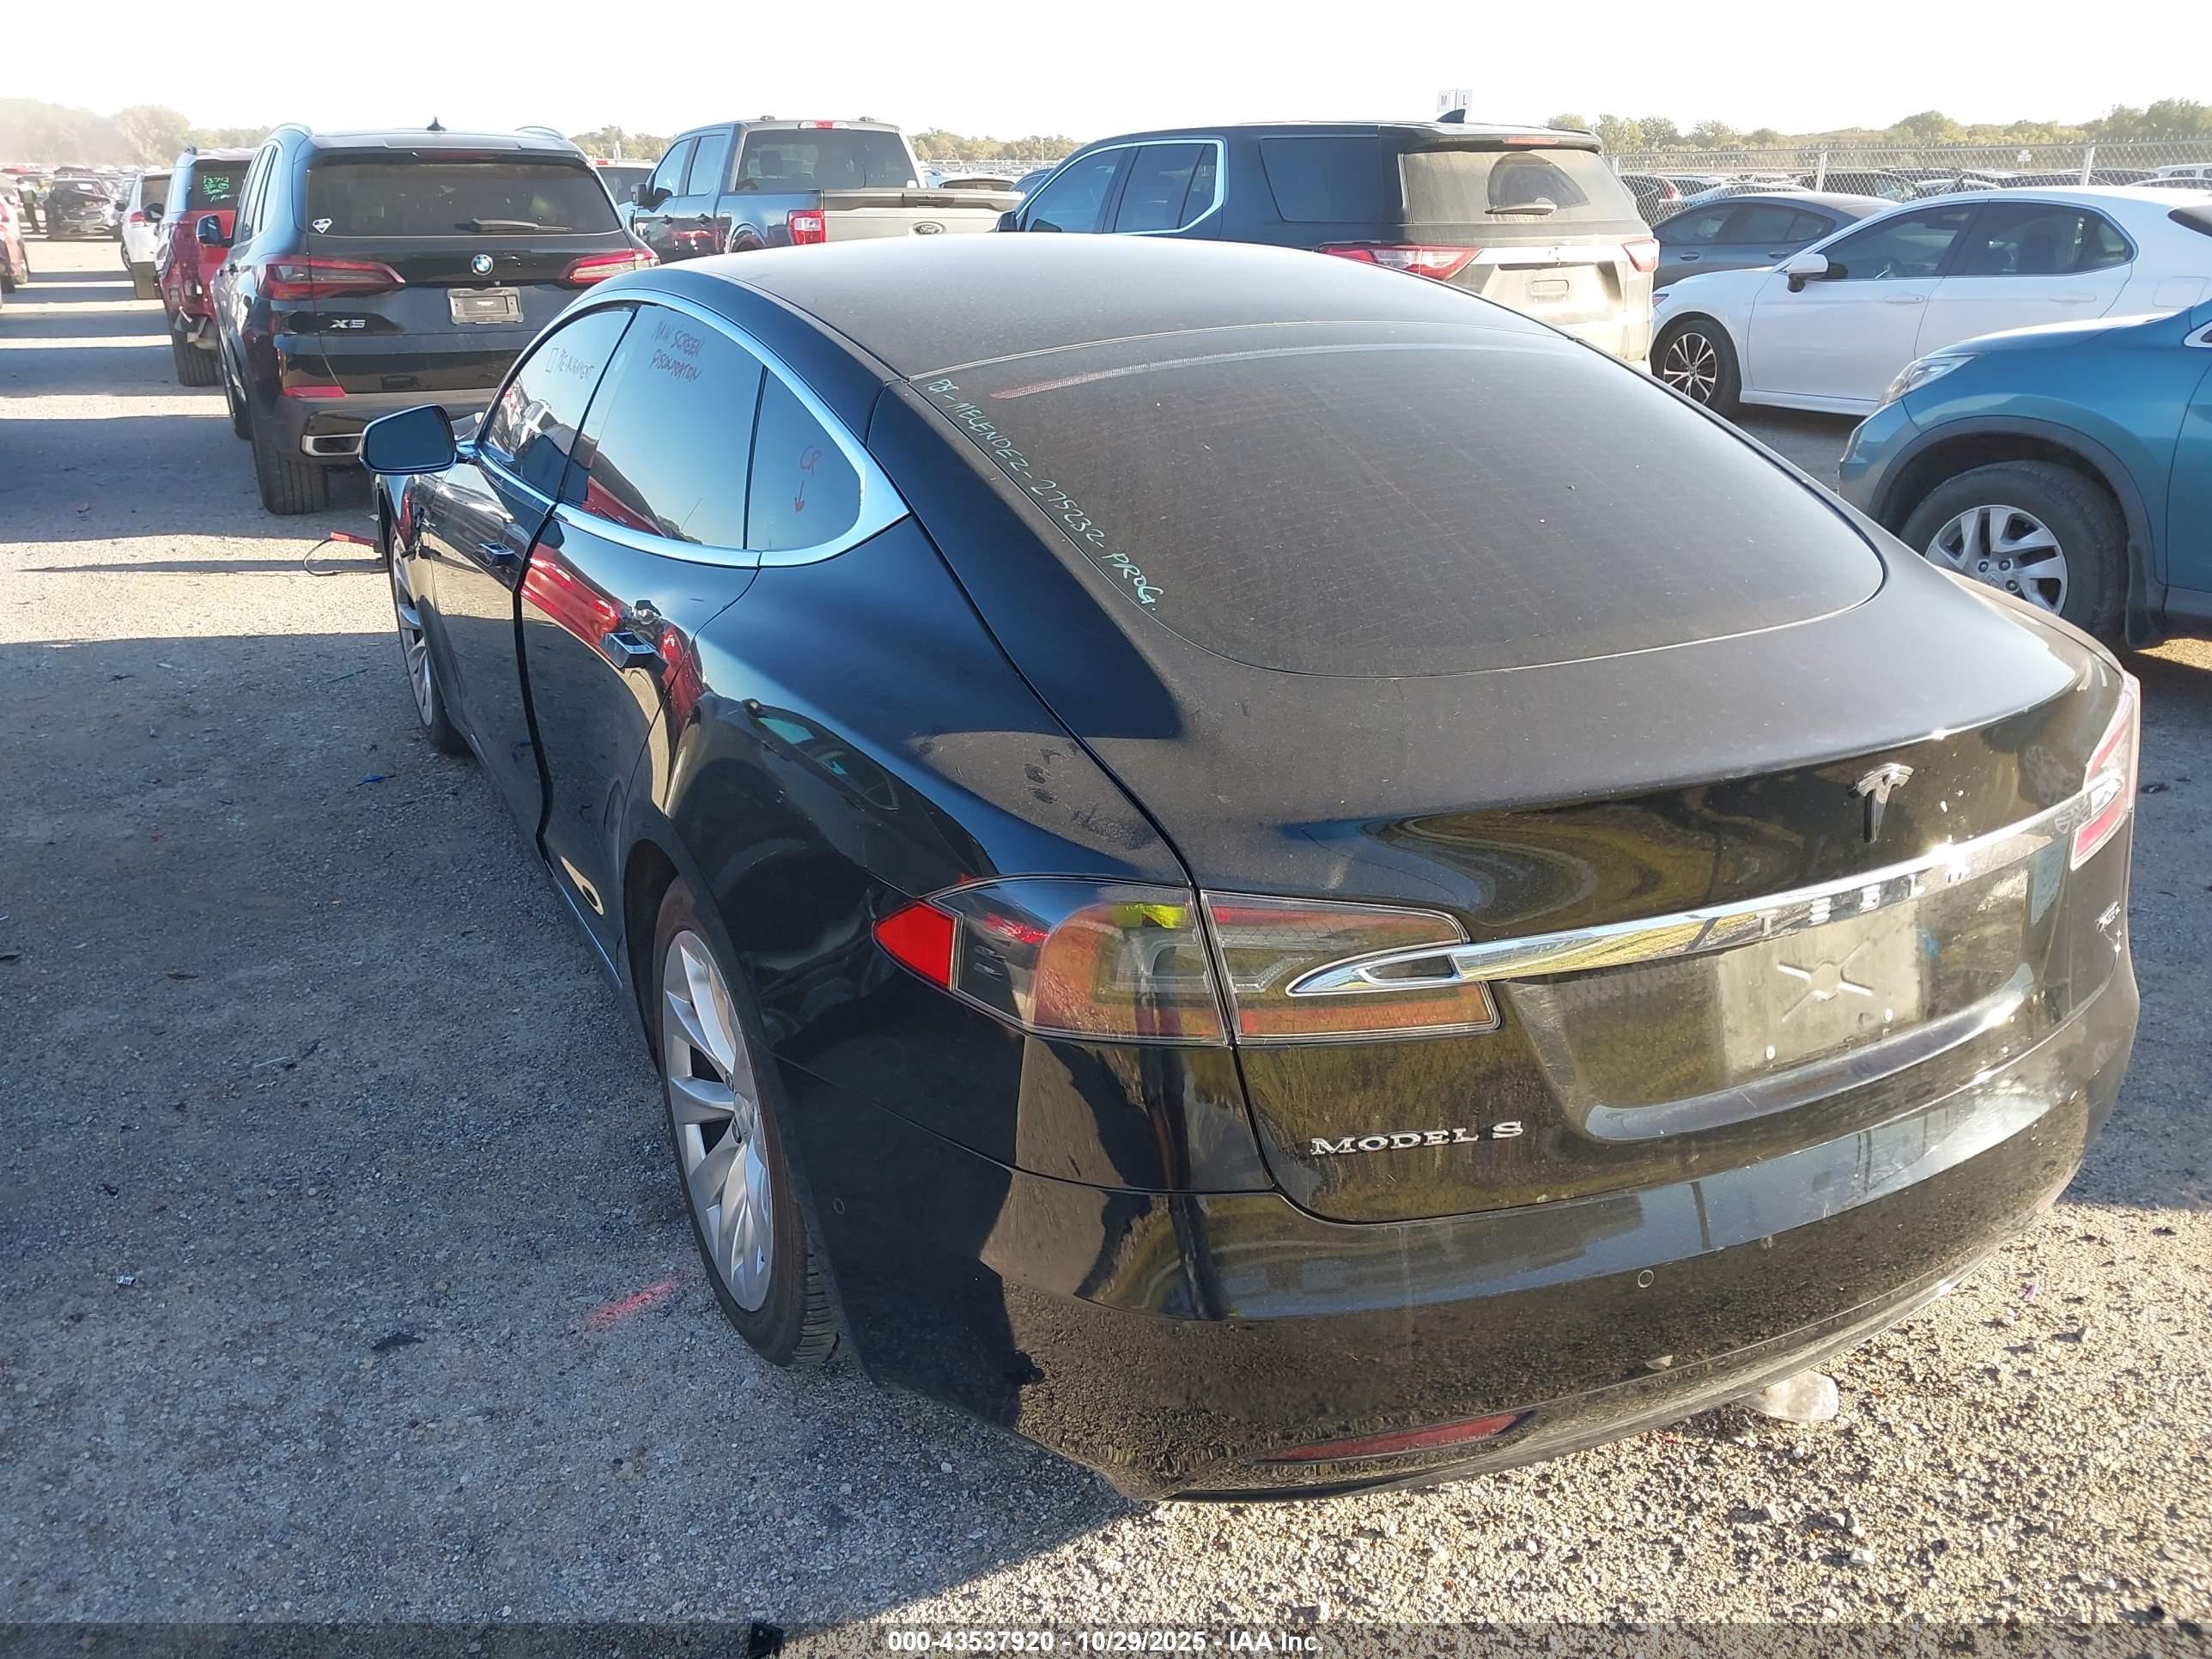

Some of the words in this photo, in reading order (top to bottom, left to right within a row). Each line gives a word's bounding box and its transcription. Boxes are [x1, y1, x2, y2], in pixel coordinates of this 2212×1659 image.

[329, 319, 366, 329] X5
[1310, 1127, 1480, 1156] MODEL
[1492, 1120, 1524, 1139] S
